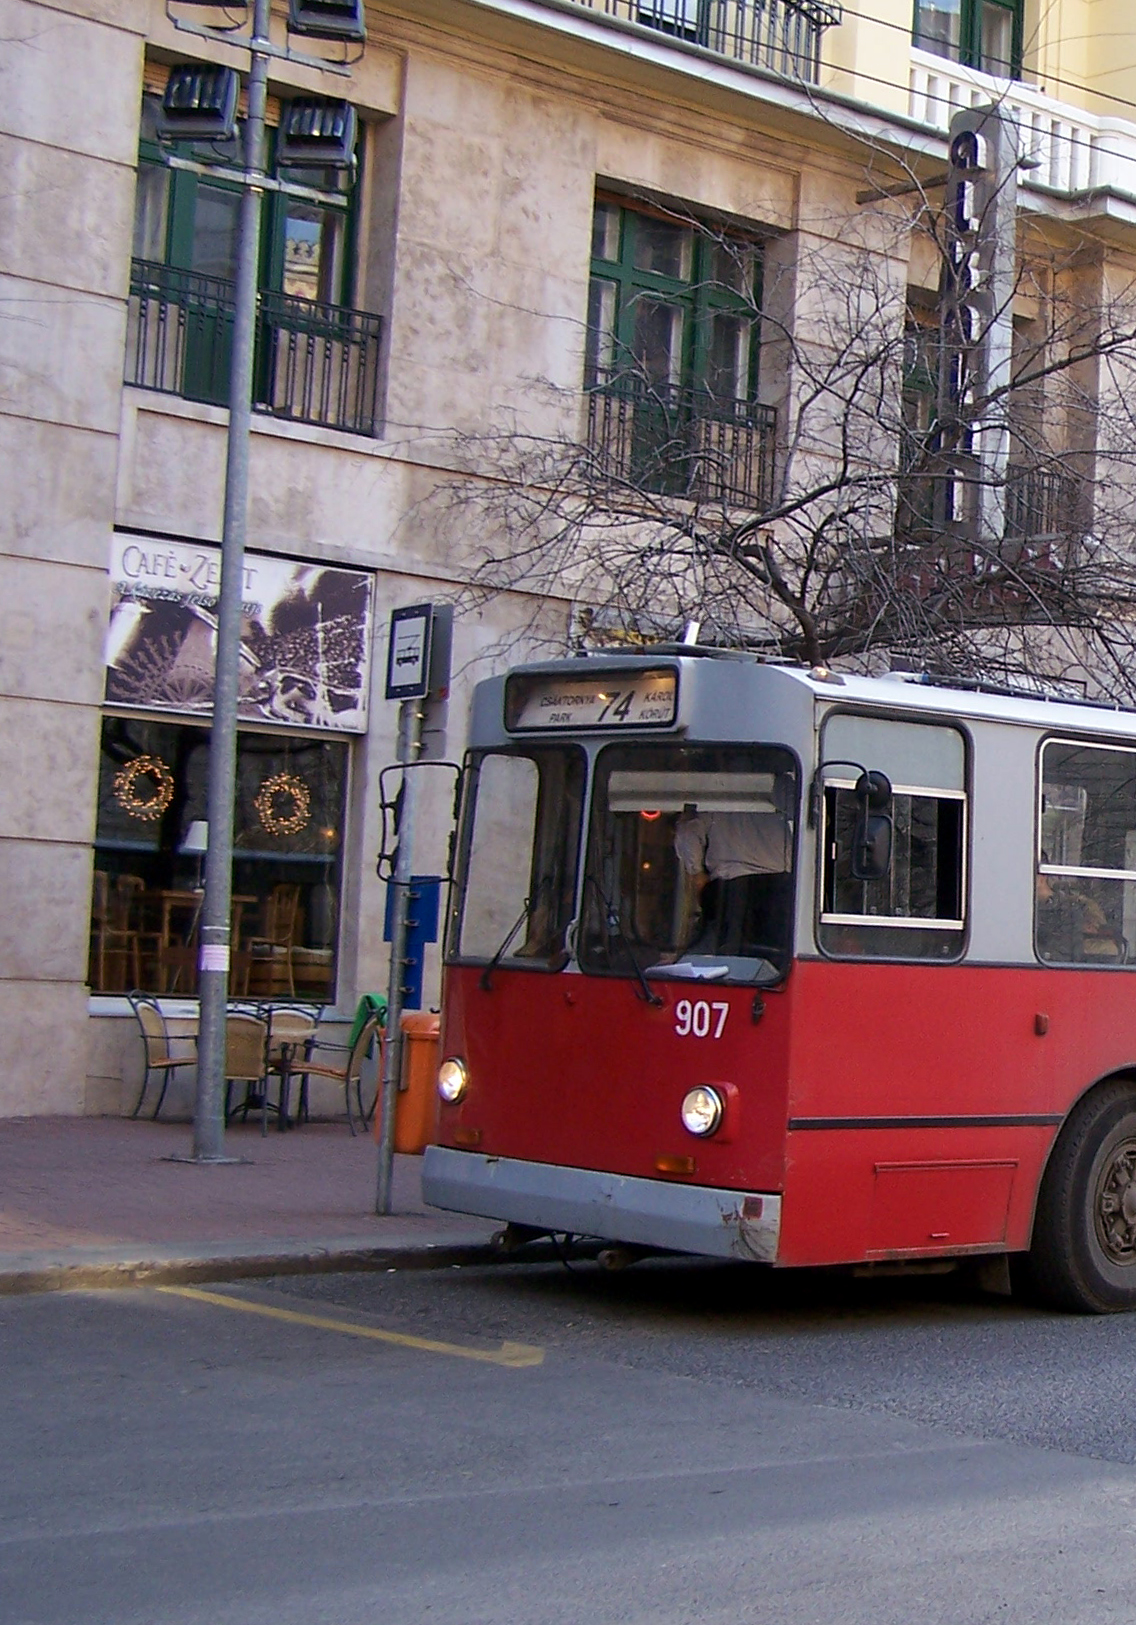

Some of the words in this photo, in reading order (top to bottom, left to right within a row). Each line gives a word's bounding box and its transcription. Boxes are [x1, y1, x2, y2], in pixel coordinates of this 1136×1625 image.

[550, 712, 574, 723] PARK
[598, 690, 636, 722] 74
[675, 999, 730, 1039] 907
